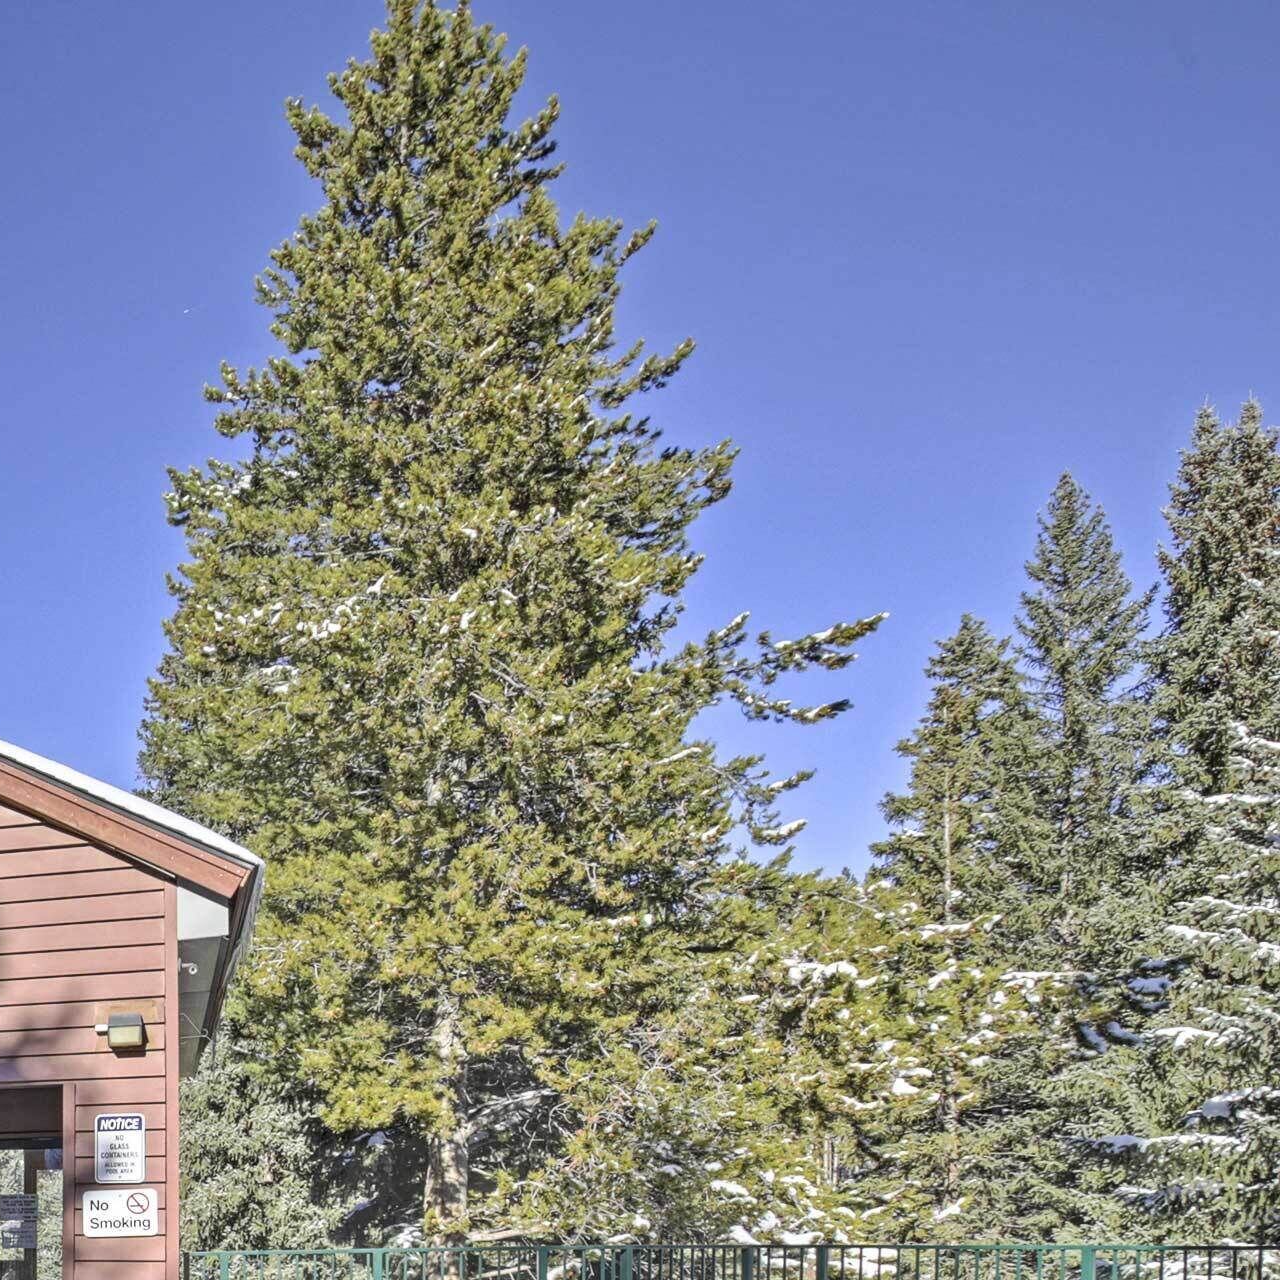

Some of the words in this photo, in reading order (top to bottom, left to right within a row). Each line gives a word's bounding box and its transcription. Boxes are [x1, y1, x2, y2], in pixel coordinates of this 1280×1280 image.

[100, 1118, 140, 1130] NOTICE
[90, 1200, 109, 1211] No
[90, 1217, 151, 1230] Smoking
